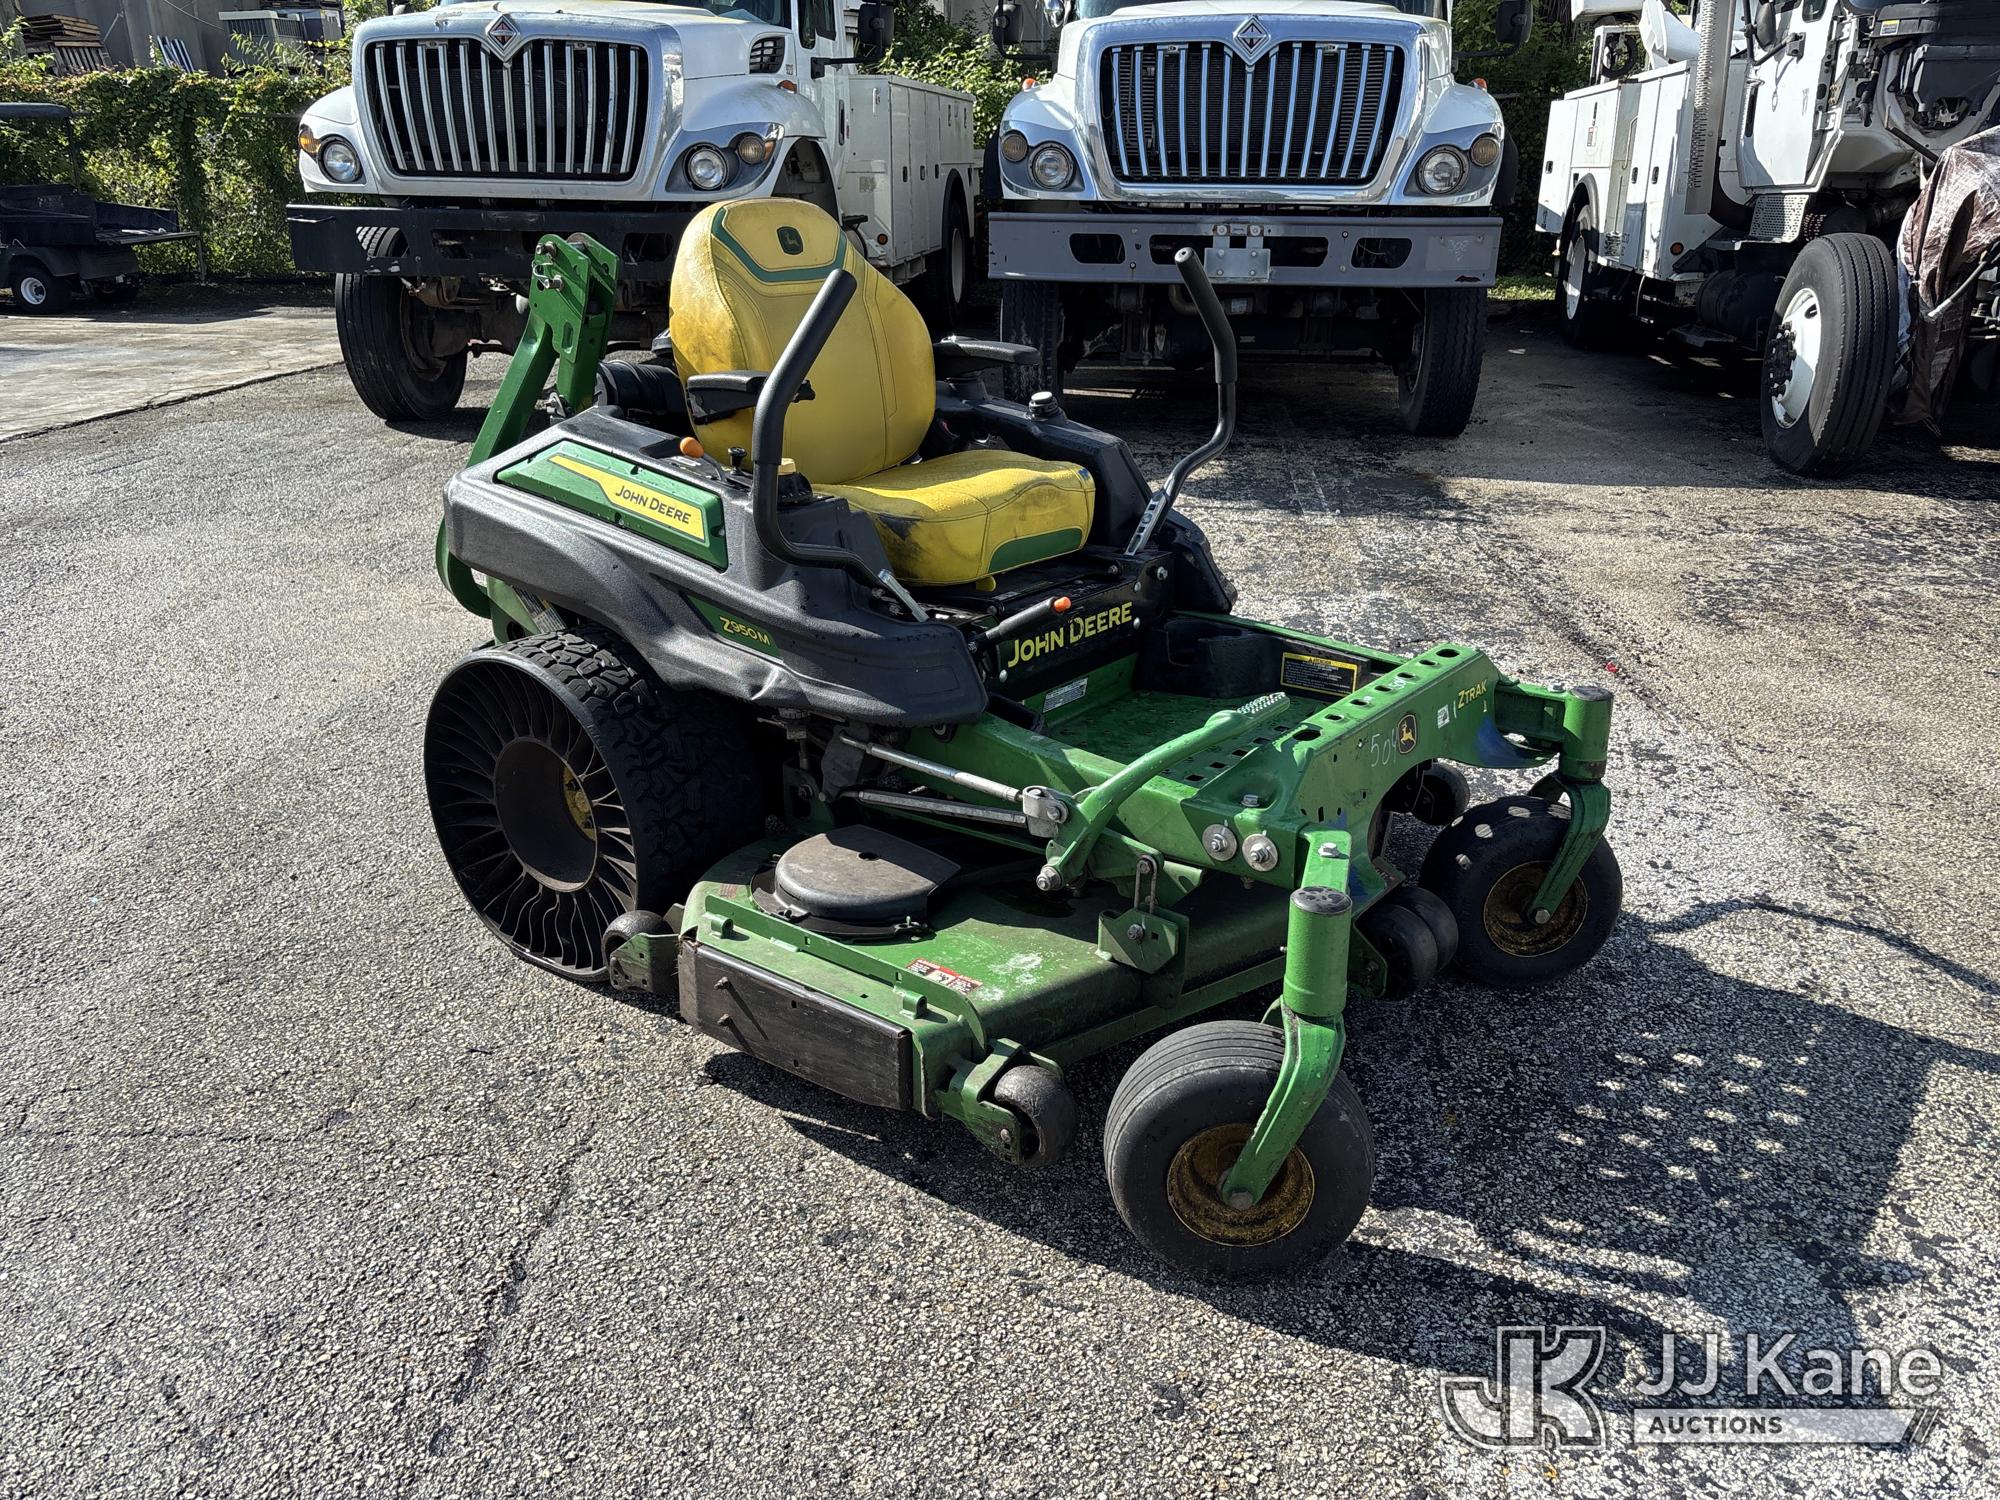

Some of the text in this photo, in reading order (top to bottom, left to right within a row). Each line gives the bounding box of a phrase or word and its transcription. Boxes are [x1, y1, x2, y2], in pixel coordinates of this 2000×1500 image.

[616, 485, 691, 524] JOHN DEERE
[719, 616, 770, 645] Z950M
[1008, 602, 1132, 668] JOHN DEERE
[1457, 680, 1488, 709] ZTRAK
